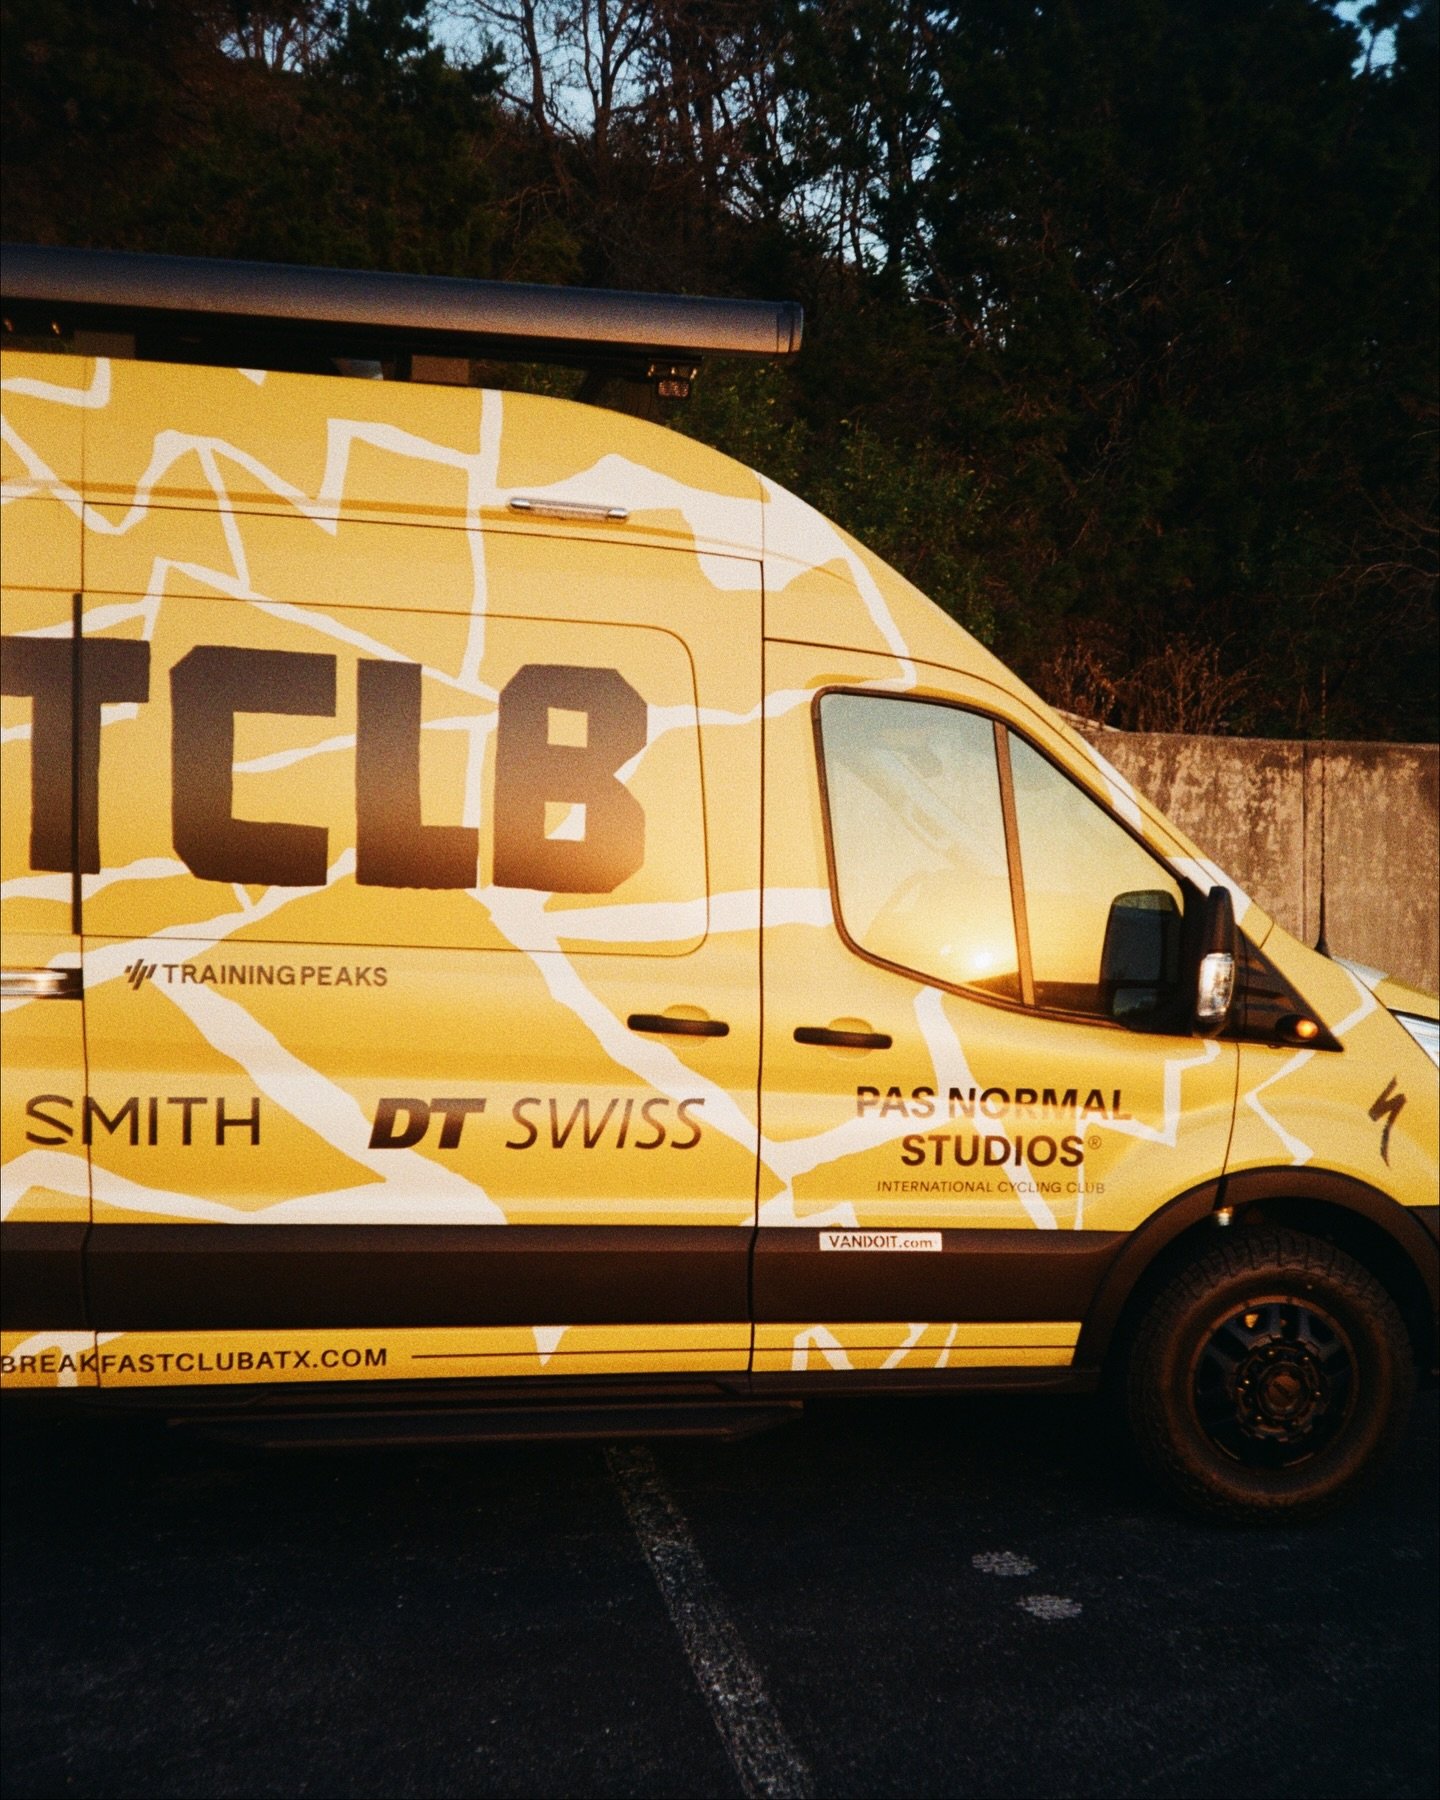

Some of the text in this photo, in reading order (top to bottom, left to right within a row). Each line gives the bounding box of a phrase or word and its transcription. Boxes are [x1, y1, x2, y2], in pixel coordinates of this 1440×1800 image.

[856, 1086, 1132, 1120] PAS NORMAL
[25, 1094, 261, 1146] SMITH
[368, 1097, 706, 1150] DT SWISS
[877, 1181, 1105, 1194] INTERNATIONAL CYCLING CLUB
[829, 1235, 933, 1248] VANDOIT.com
[0, 1348, 388, 1373] BREAKFASTCLUBATX.COM
